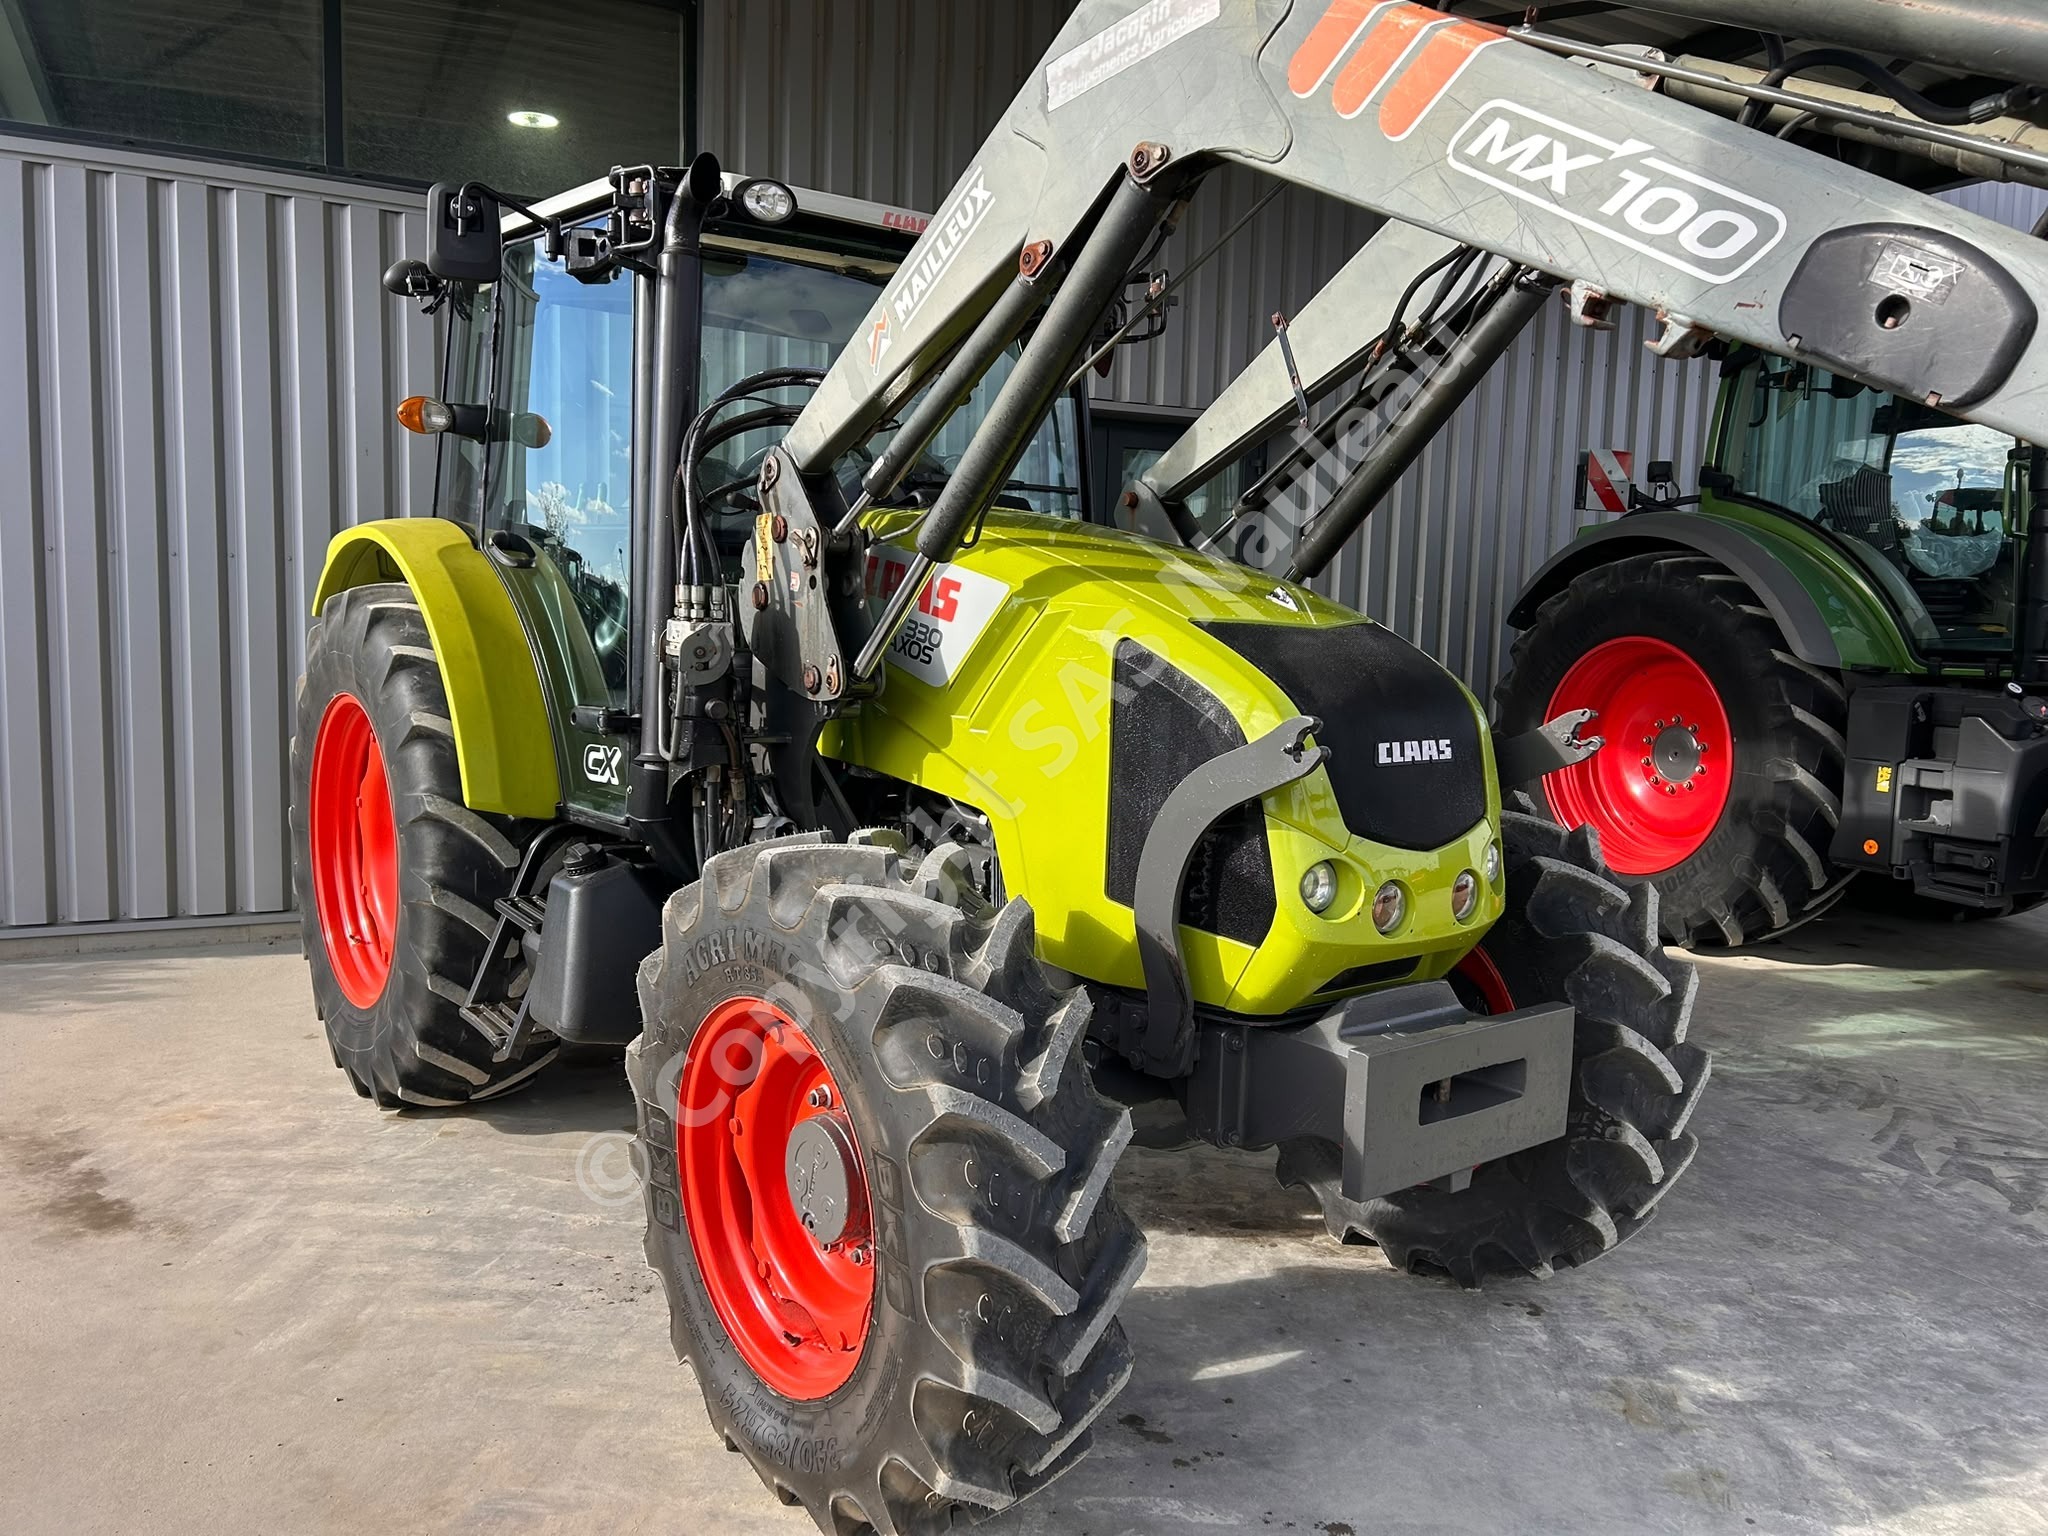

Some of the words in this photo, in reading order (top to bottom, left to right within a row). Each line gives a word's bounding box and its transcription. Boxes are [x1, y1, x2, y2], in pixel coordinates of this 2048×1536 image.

[1140, 4, 1208, 52] Agricoles
[1464, 117, 1604, 196] MX
[1598, 168, 1758, 259] 100
[894, 174, 992, 323] MAILLEUX
[904, 618, 943, 649] 330
[584, 744, 622, 785] CX
[1378, 739, 1452, 764] CLAAS
[683, 927, 738, 988] AGRI
